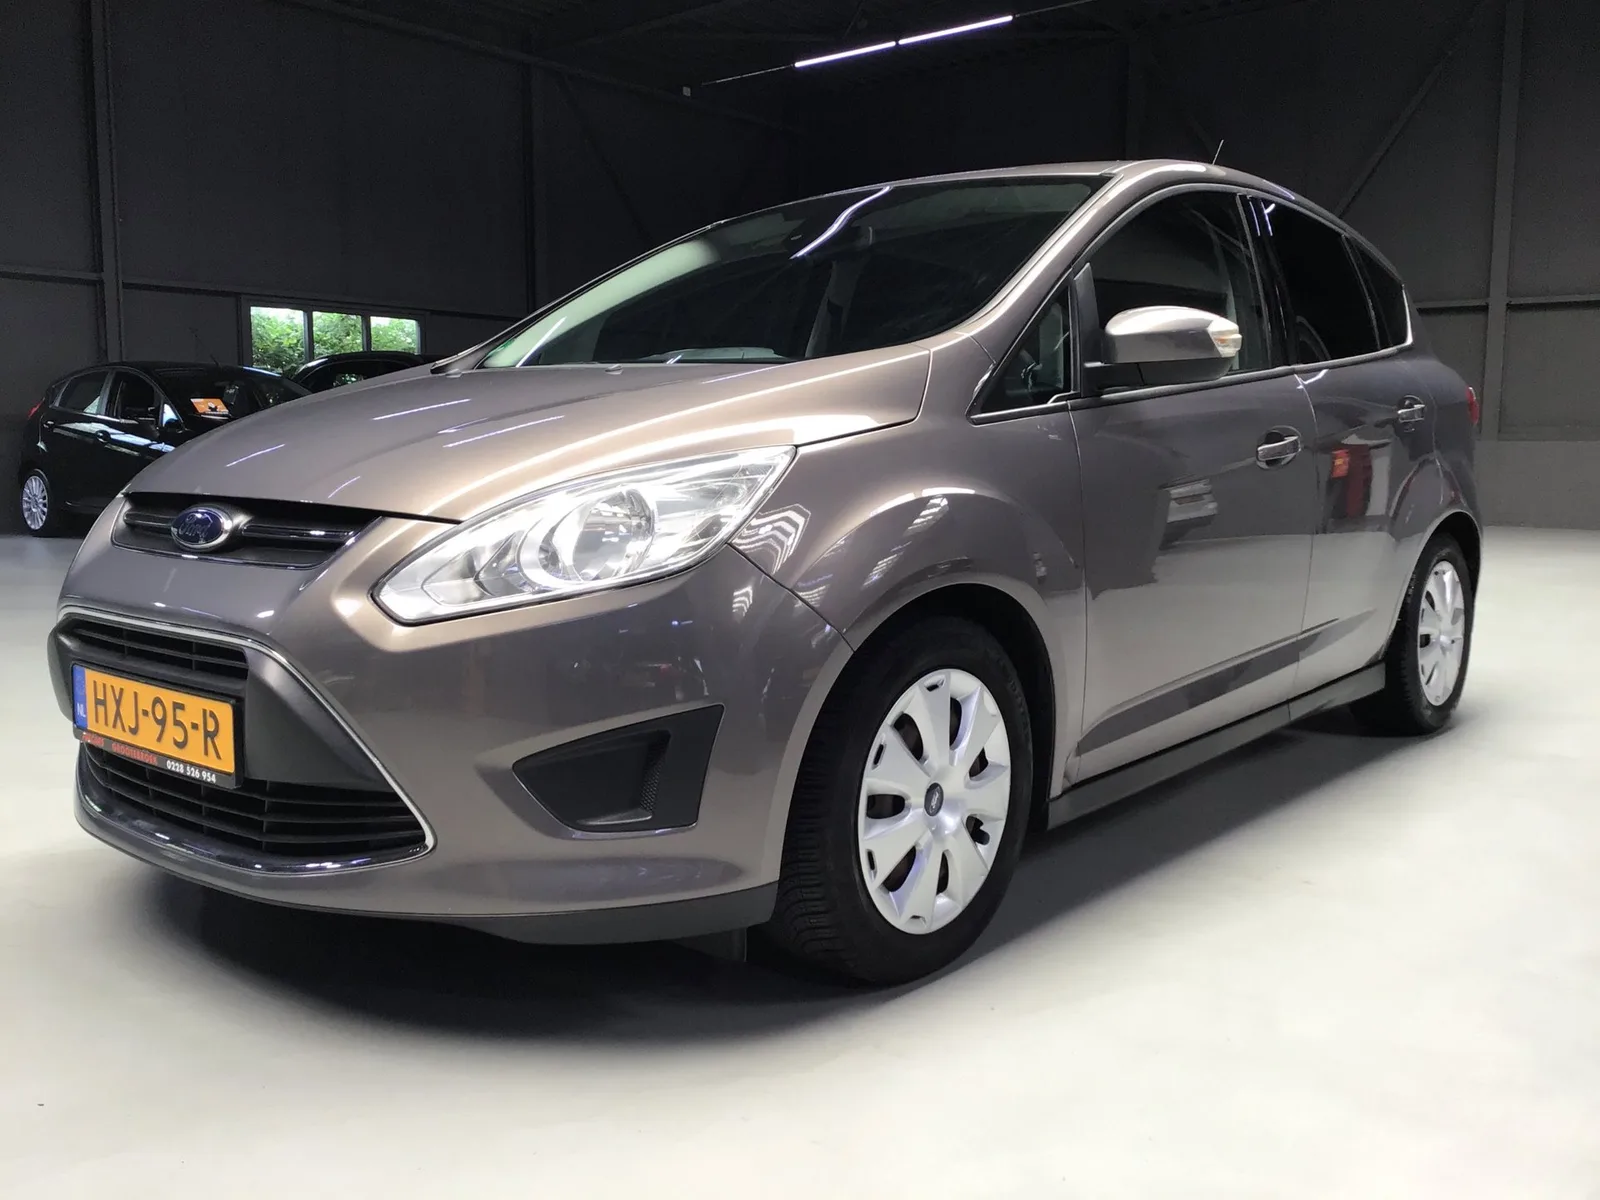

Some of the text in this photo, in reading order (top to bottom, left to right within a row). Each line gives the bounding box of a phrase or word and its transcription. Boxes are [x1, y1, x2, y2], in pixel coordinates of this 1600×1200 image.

[76, 702, 87, 719] NL
[93, 680, 222, 760] HXJ-95-R
[166, 759, 185, 774] 0228
[185, 766, 200, 779] 526
[201, 771, 217, 784] 954
